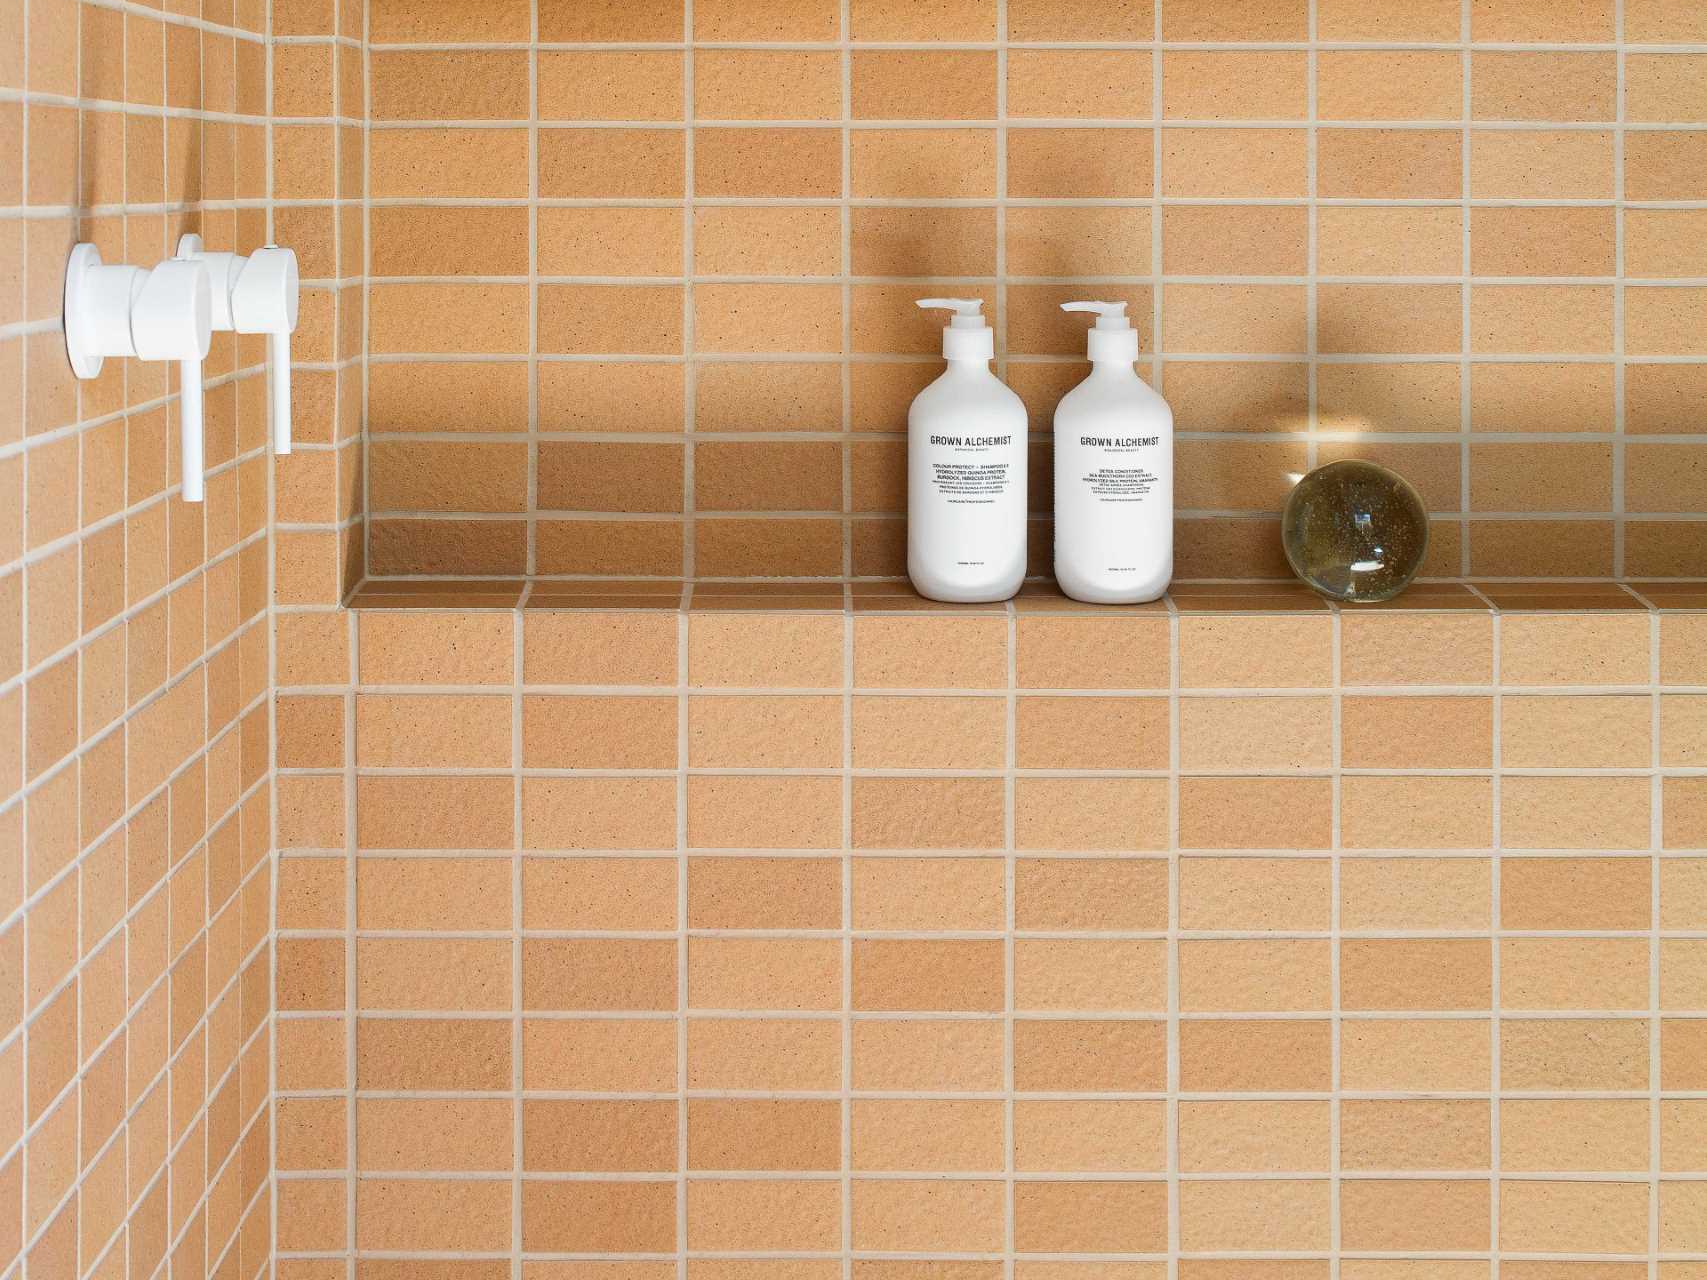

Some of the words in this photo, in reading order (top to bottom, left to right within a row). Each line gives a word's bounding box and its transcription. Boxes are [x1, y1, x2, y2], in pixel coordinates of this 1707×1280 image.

[930, 435, 962, 446] GROWN
[964, 435, 1012, 447] ALCHEMIST
[1080, 436, 1112, 447] GROWN
[1114, 436, 1160, 447] ALCHEMIST
